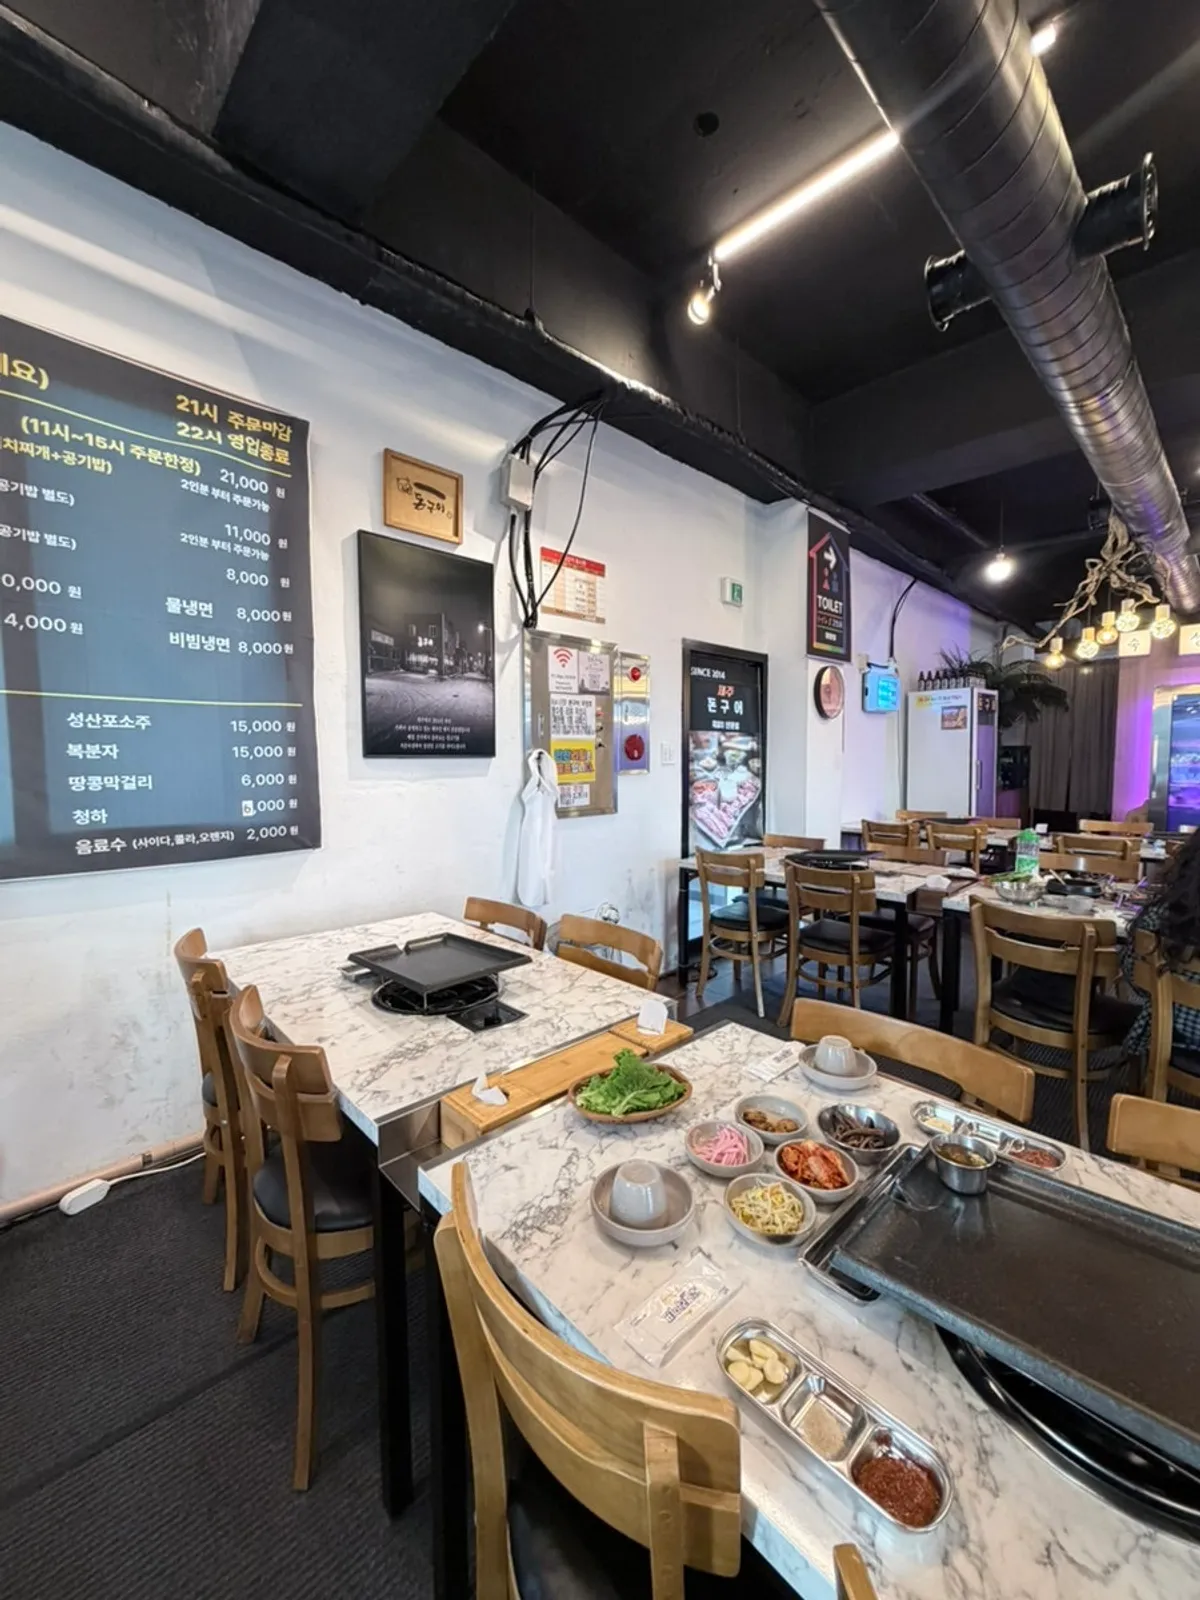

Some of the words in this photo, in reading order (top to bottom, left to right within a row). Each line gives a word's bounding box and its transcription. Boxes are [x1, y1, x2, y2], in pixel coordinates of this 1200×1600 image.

[176, 395, 218, 424] 21시
[227, 410, 293, 442] 주문마감
[21, 415, 125, 456] (11시~15시
[129, 443, 201, 476] 주문한정)
[176, 421, 222, 445] 22시
[227, 433, 291, 466] 영업종료
[0, 436, 113, 475] 치찌개+공기밥)
[180, 479, 209, 497] 2인분
[211, 487, 231, 503] 부터
[220, 468, 269, 494] 21,000
[276, 487, 286, 499] 원
[42, 487, 75, 507] 별도)
[43, 533, 77, 551] 별도)
[180, 532, 209, 549] 2인분
[211, 539, 231, 553] 부터
[224, 523, 271, 546] 11,000
[278, 538, 288, 549] 원
[1, 573, 61, 595] 0,000
[68, 585, 82, 599] 원
[226, 568, 269, 587] 8,000
[280, 577, 290, 588] 원
[165, 596, 213, 619] 물냉면
[817, 594, 843, 615] TOILET
[4, 612, 67, 632] 4,000
[70, 622, 83, 635] 원
[169, 631, 231, 653] 비빔냉면
[690, 666, 711, 677] SINCE
[67, 712, 152, 730] 성산포소주
[230, 720, 282, 735] 15,000
[286, 722, 296, 733] 원
[66, 743, 119, 759] 복분자
[231, 746, 283, 760] 15,000
[287, 747, 296, 758] 원
[68, 775, 153, 791] 땅콩막걸리
[241, 774, 284, 788] 6,000
[288, 774, 297, 785] 원
[72, 808, 108, 825] 청하
[288, 798, 298, 809] 원
[75, 837, 127, 855] 음료수
[246, 825, 287, 842] 2,000
[290, 825, 299, 836] 원
